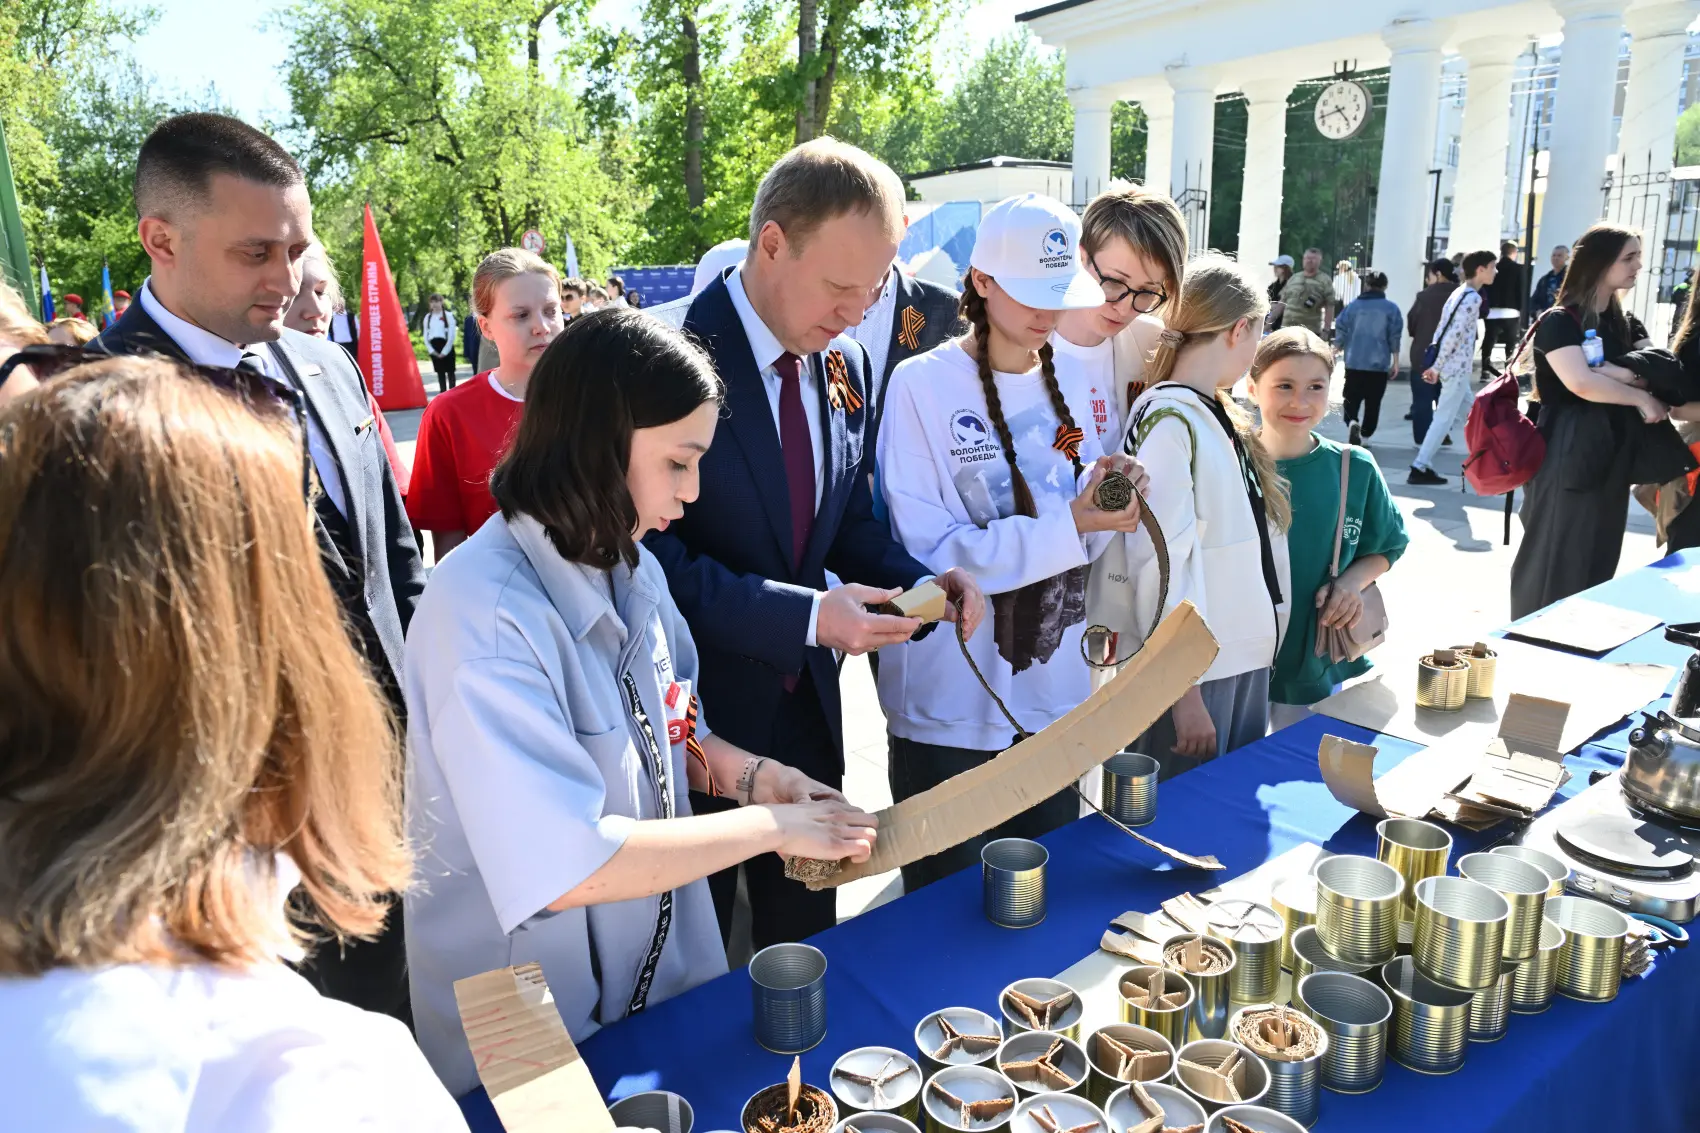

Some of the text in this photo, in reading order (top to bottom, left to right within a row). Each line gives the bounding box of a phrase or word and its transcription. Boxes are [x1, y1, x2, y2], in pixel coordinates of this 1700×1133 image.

[1039, 255, 1072, 264] ВОЛОНТЁРЫ
[367, 261, 384, 396] СОЗДАЮ БУДУЩЕЕ СТРАНЫ
[950, 444, 1001, 456] ВОЛОНТЁРЫ
[960, 452, 996, 463] ПОБЕДЫ
